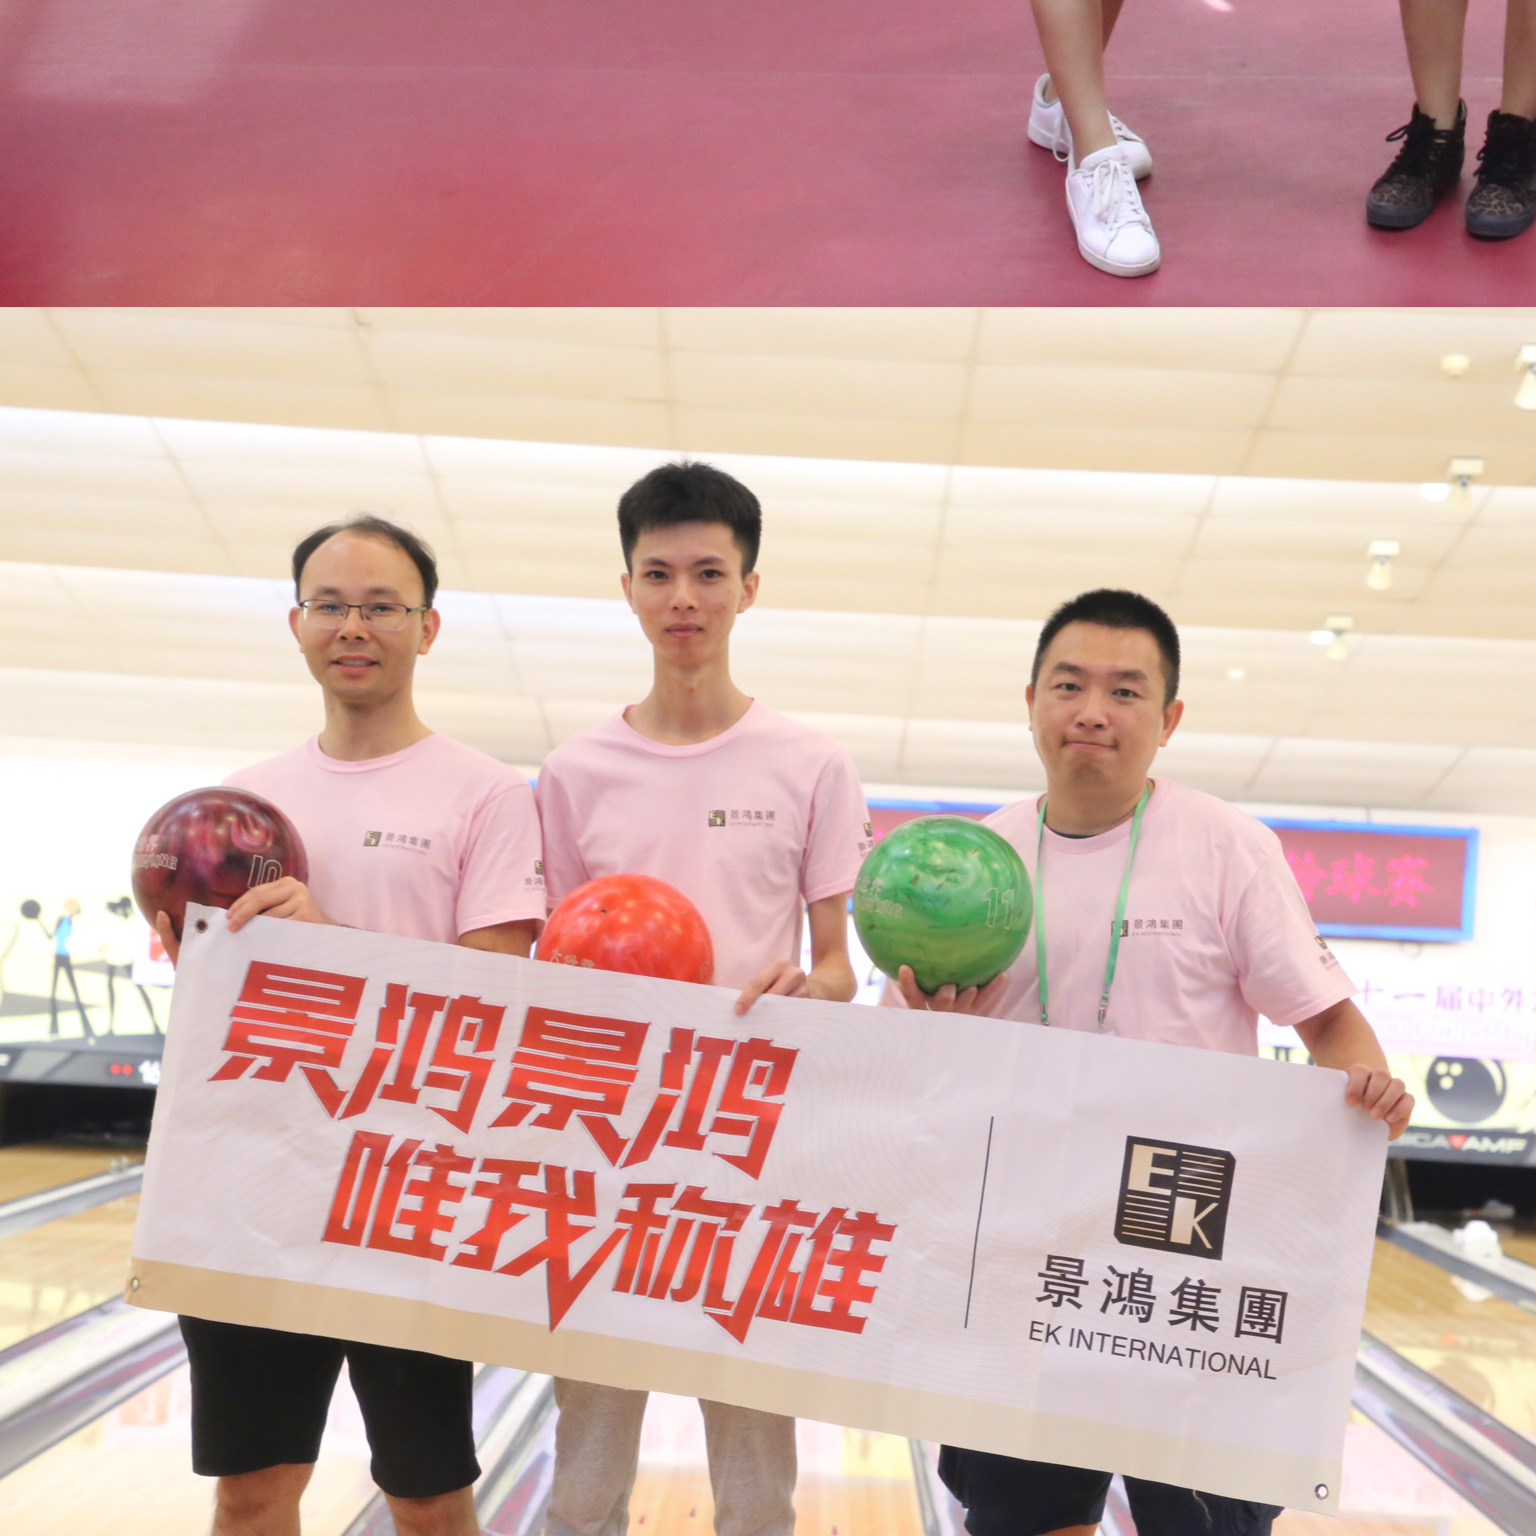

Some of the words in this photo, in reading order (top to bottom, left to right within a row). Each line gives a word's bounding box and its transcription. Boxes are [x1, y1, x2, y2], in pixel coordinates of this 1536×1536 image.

[983, 887, 1014, 930] 11
[208, 960, 800, 1181] 景鸿景鸿
[322, 1130, 898, 1345] 唯我称雄
[1127, 1143, 1220, 1250] EK
[1035, 1254, 1288, 1344] 景鴻集團
[1028, 1320, 1062, 1347] EK
[1068, 1327, 1278, 1381] INTERNATIONAL
